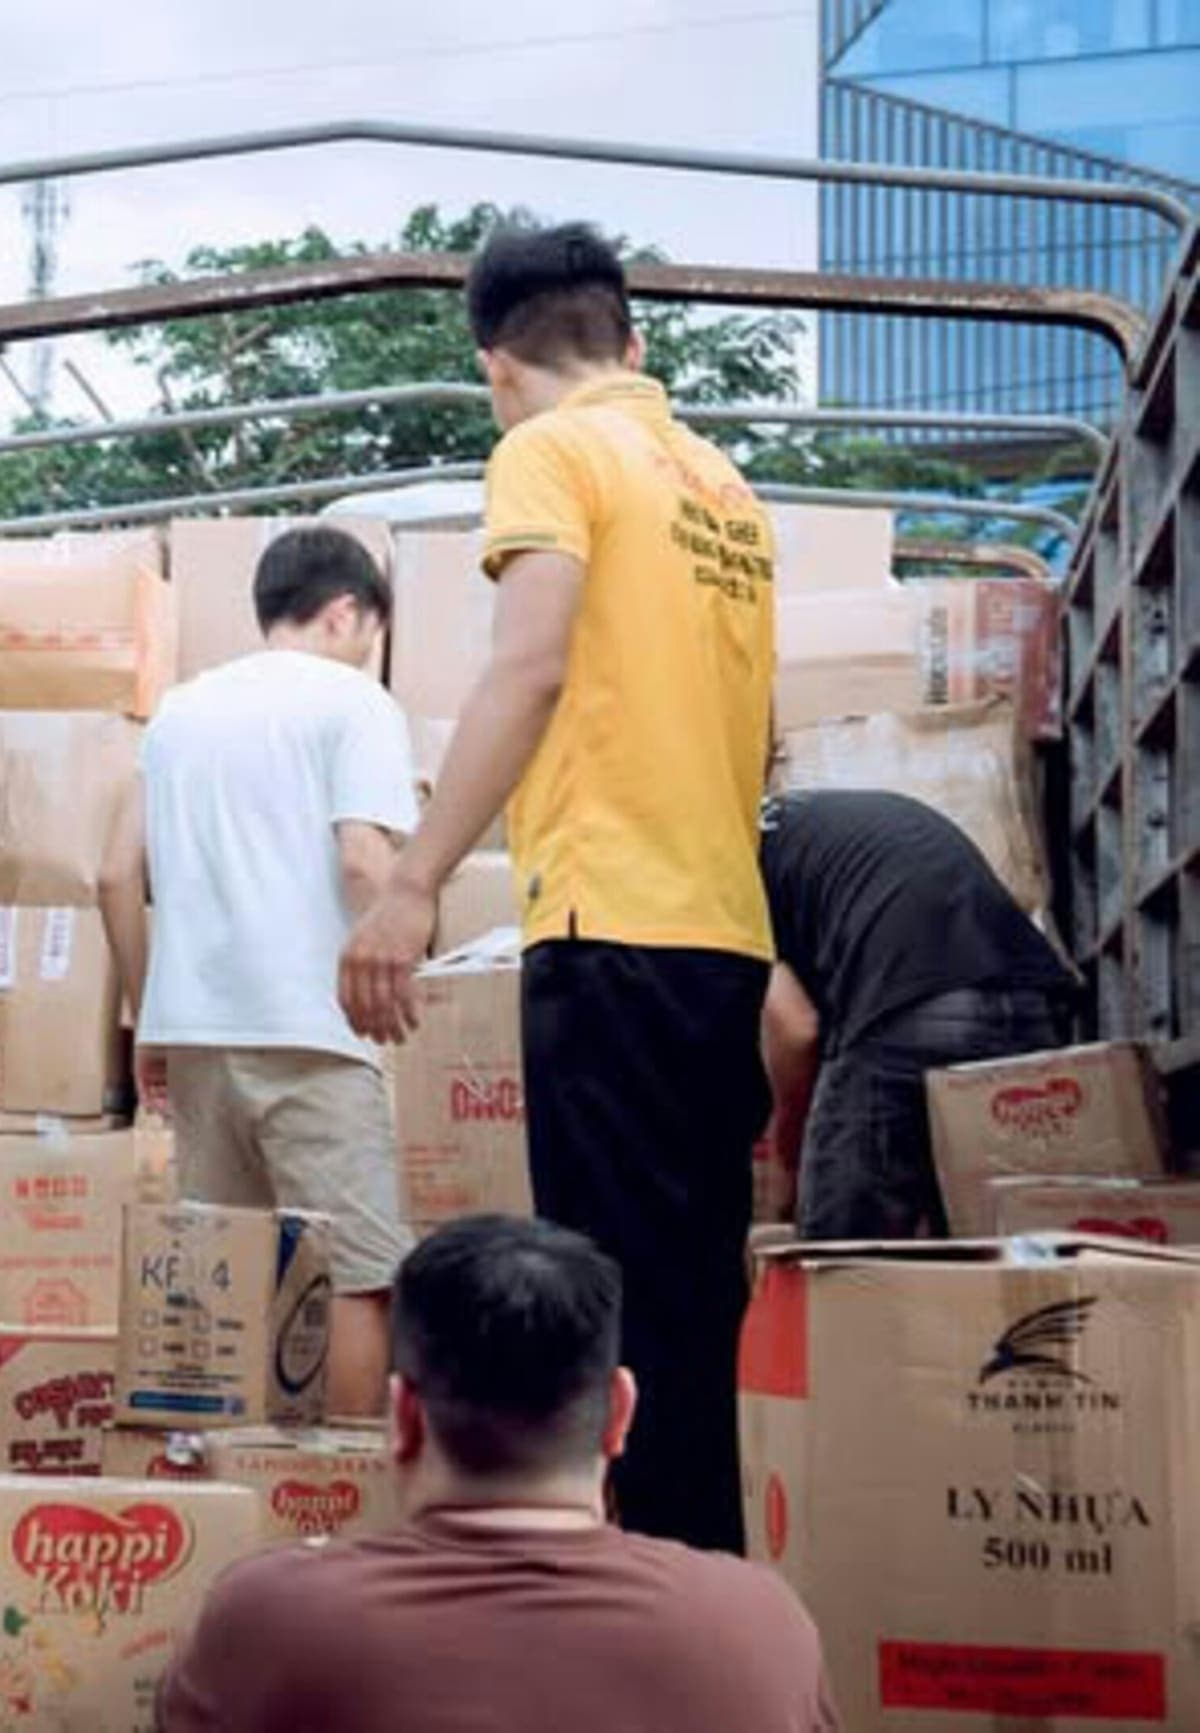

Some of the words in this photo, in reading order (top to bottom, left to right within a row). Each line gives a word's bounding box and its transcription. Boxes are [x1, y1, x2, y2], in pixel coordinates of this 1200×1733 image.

[947, 1486, 1003, 1521] LY
[22, 1519, 169, 1570] happi
[983, 1536, 1051, 1569] 500
[1065, 1542, 1113, 1575] ml
[32, 1564, 145, 1614] Koki
